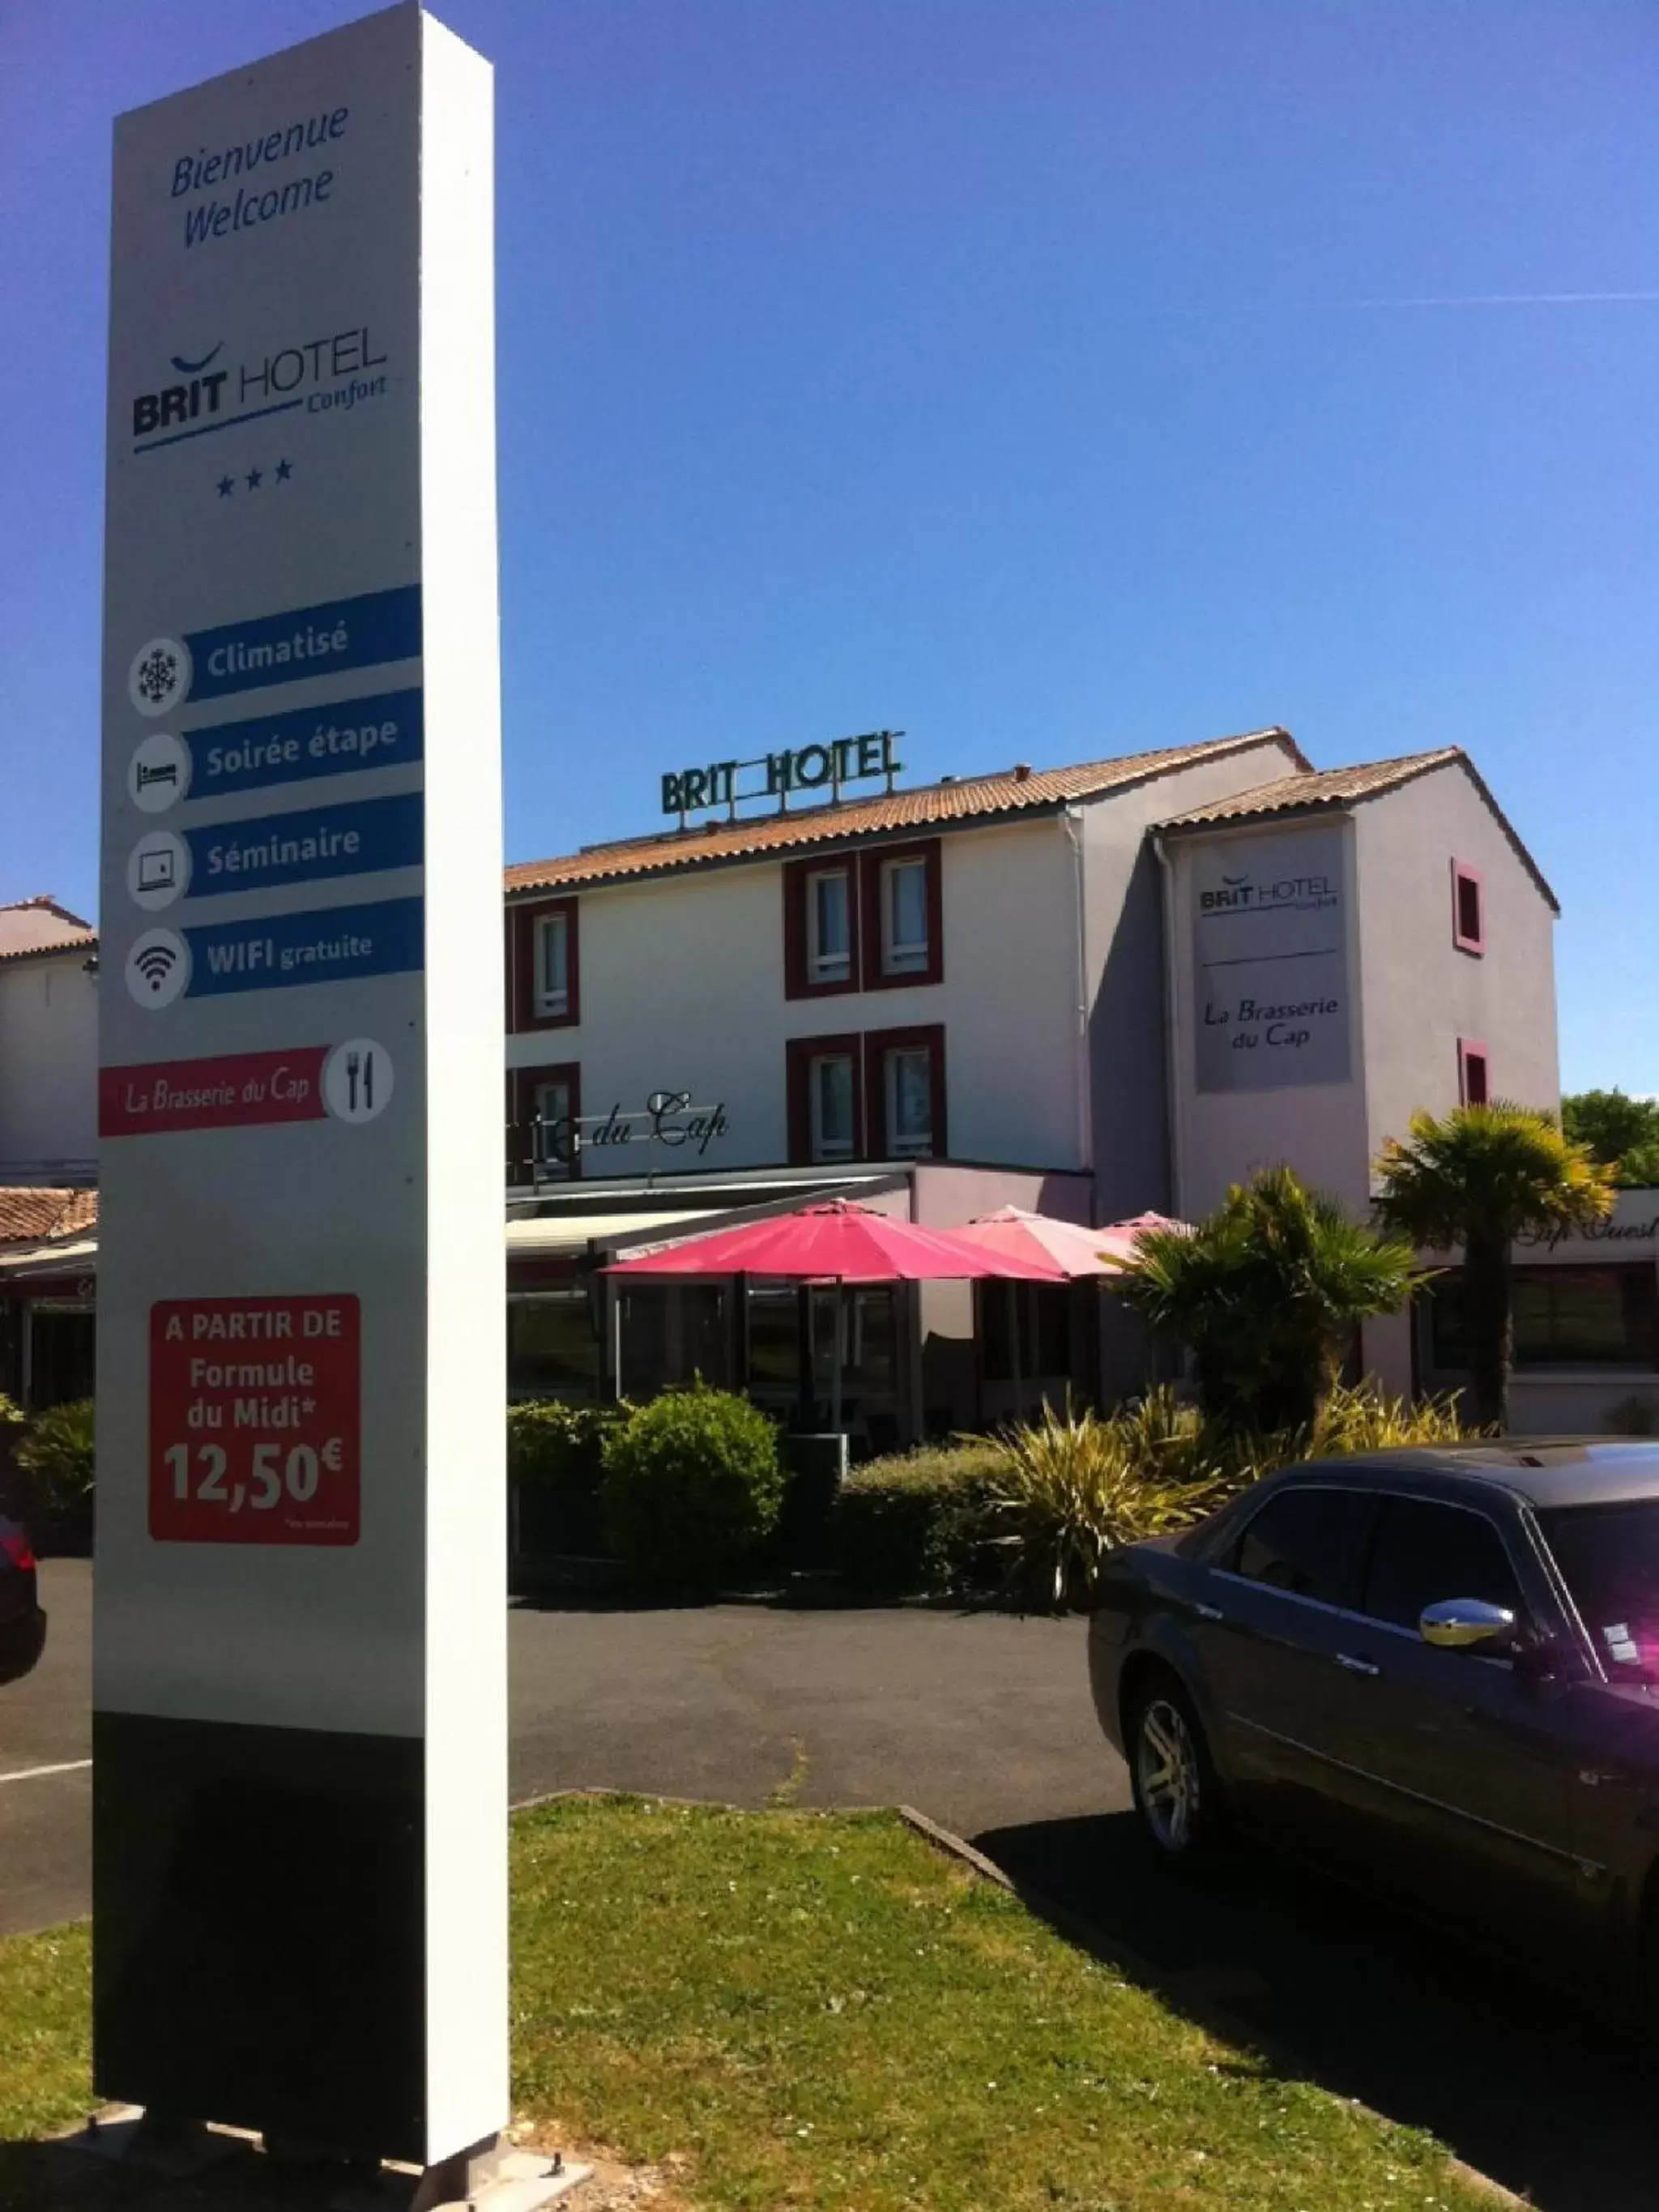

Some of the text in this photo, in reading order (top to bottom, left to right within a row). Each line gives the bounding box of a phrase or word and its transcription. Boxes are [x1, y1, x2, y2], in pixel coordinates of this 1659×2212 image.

[171, 106, 348, 198] Bienvenue
[186, 169, 334, 249] Welcome
[134, 327, 387, 436] BRIT HOTEL
[307, 375, 387, 414] Confort
[207, 621, 348, 677] Climatisé
[207, 720, 399, 776] Soirée étape
[661, 730, 904, 814] BRIT HOTEL
[207, 828, 361, 875] Séminaire
[1201, 876, 1337, 910] BRIT HOTEL
[207, 936, 373, 974] WIFI gratuite
[1205, 998, 1338, 1026] La Brasserie
[1232, 1023, 1310, 1049] du Cap
[125, 1066, 309, 1113] La Brasserie du Cap
[591, 1103, 631, 1147] du
[647, 1091, 729, 1156] Cap
[165, 1309, 342, 1341] A PARTIR DE
[190, 1355, 314, 1387] Formule
[187, 1398, 223, 1428] du
